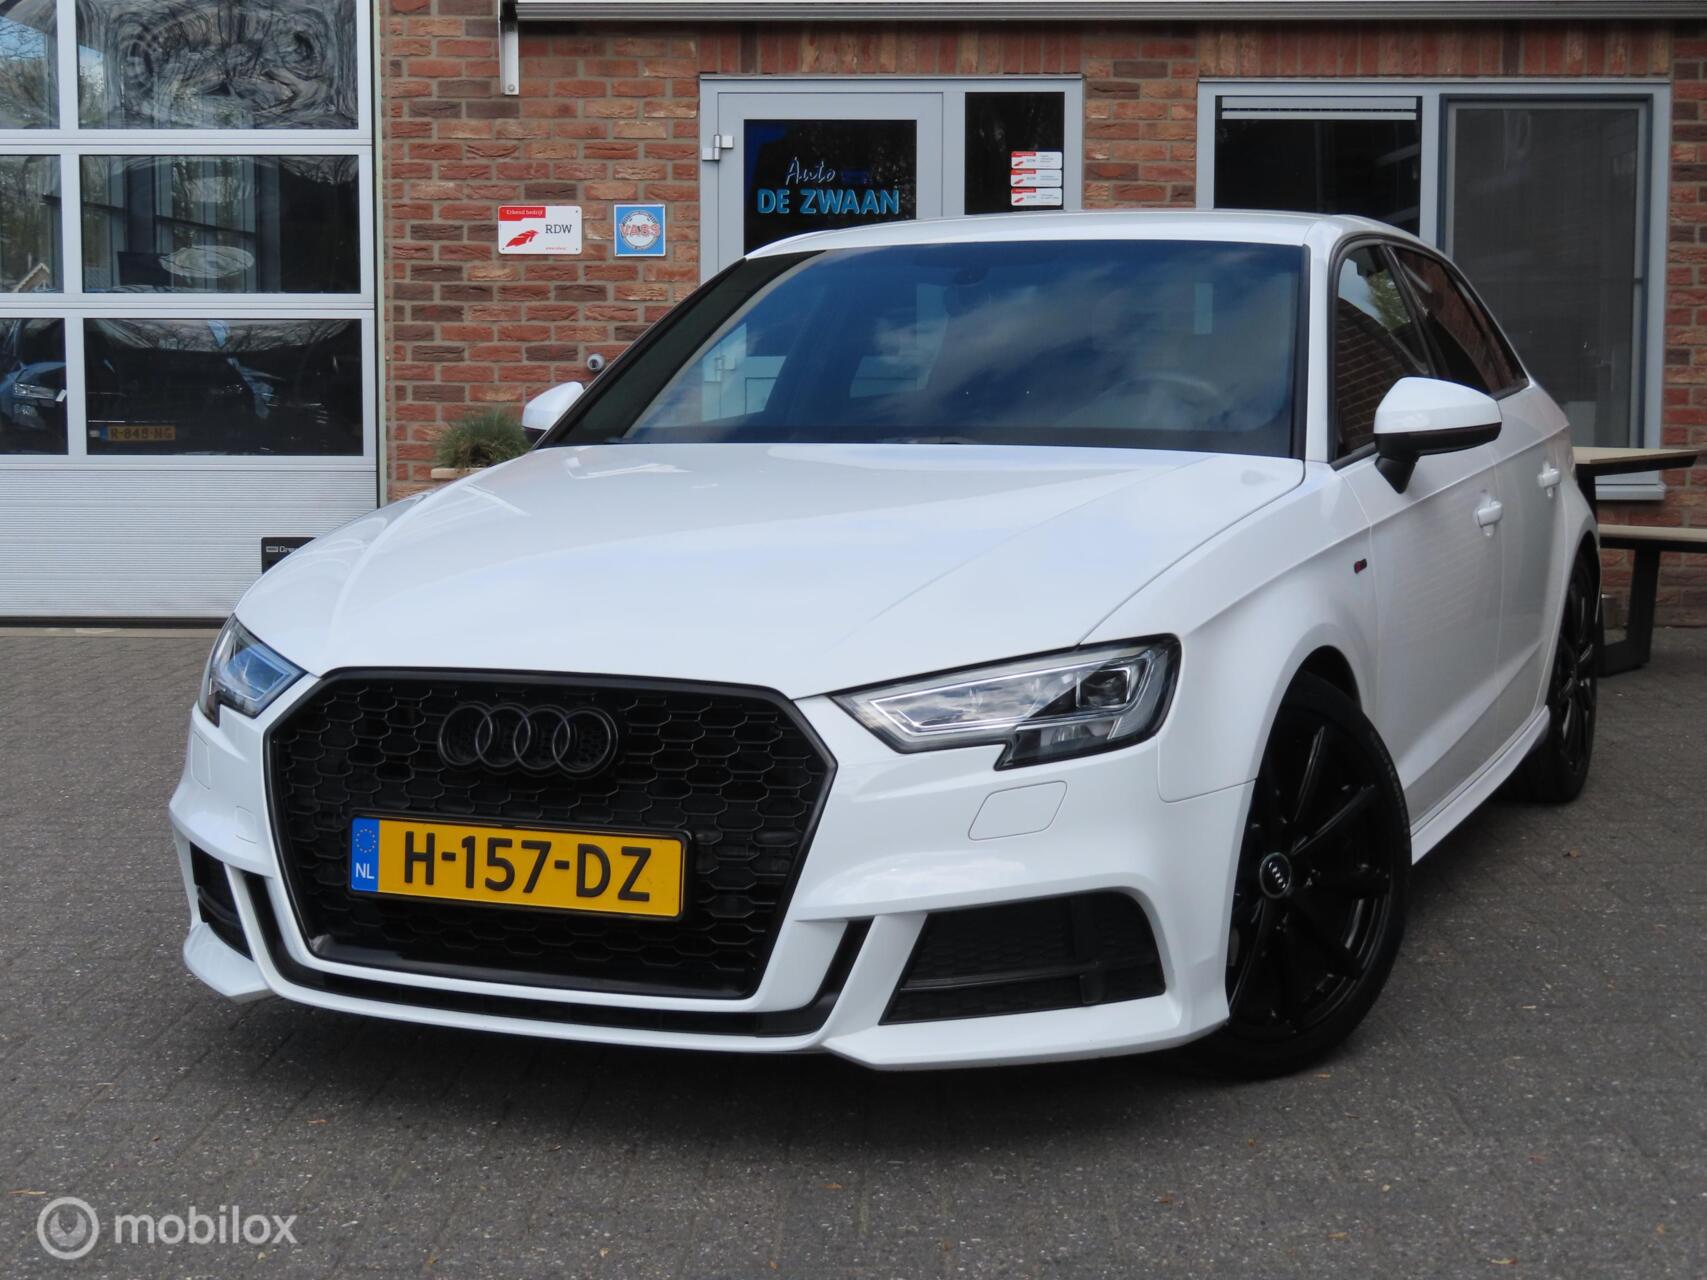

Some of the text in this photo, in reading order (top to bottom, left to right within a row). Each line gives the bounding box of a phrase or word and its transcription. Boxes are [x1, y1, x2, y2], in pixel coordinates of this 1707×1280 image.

[785, 156, 836, 186] Auto
[757, 188, 900, 215] DE ZWAAN
[545, 224, 573, 234] RDW
[355, 862, 375, 880] NL
[404, 831, 652, 902] H-157-DZ
